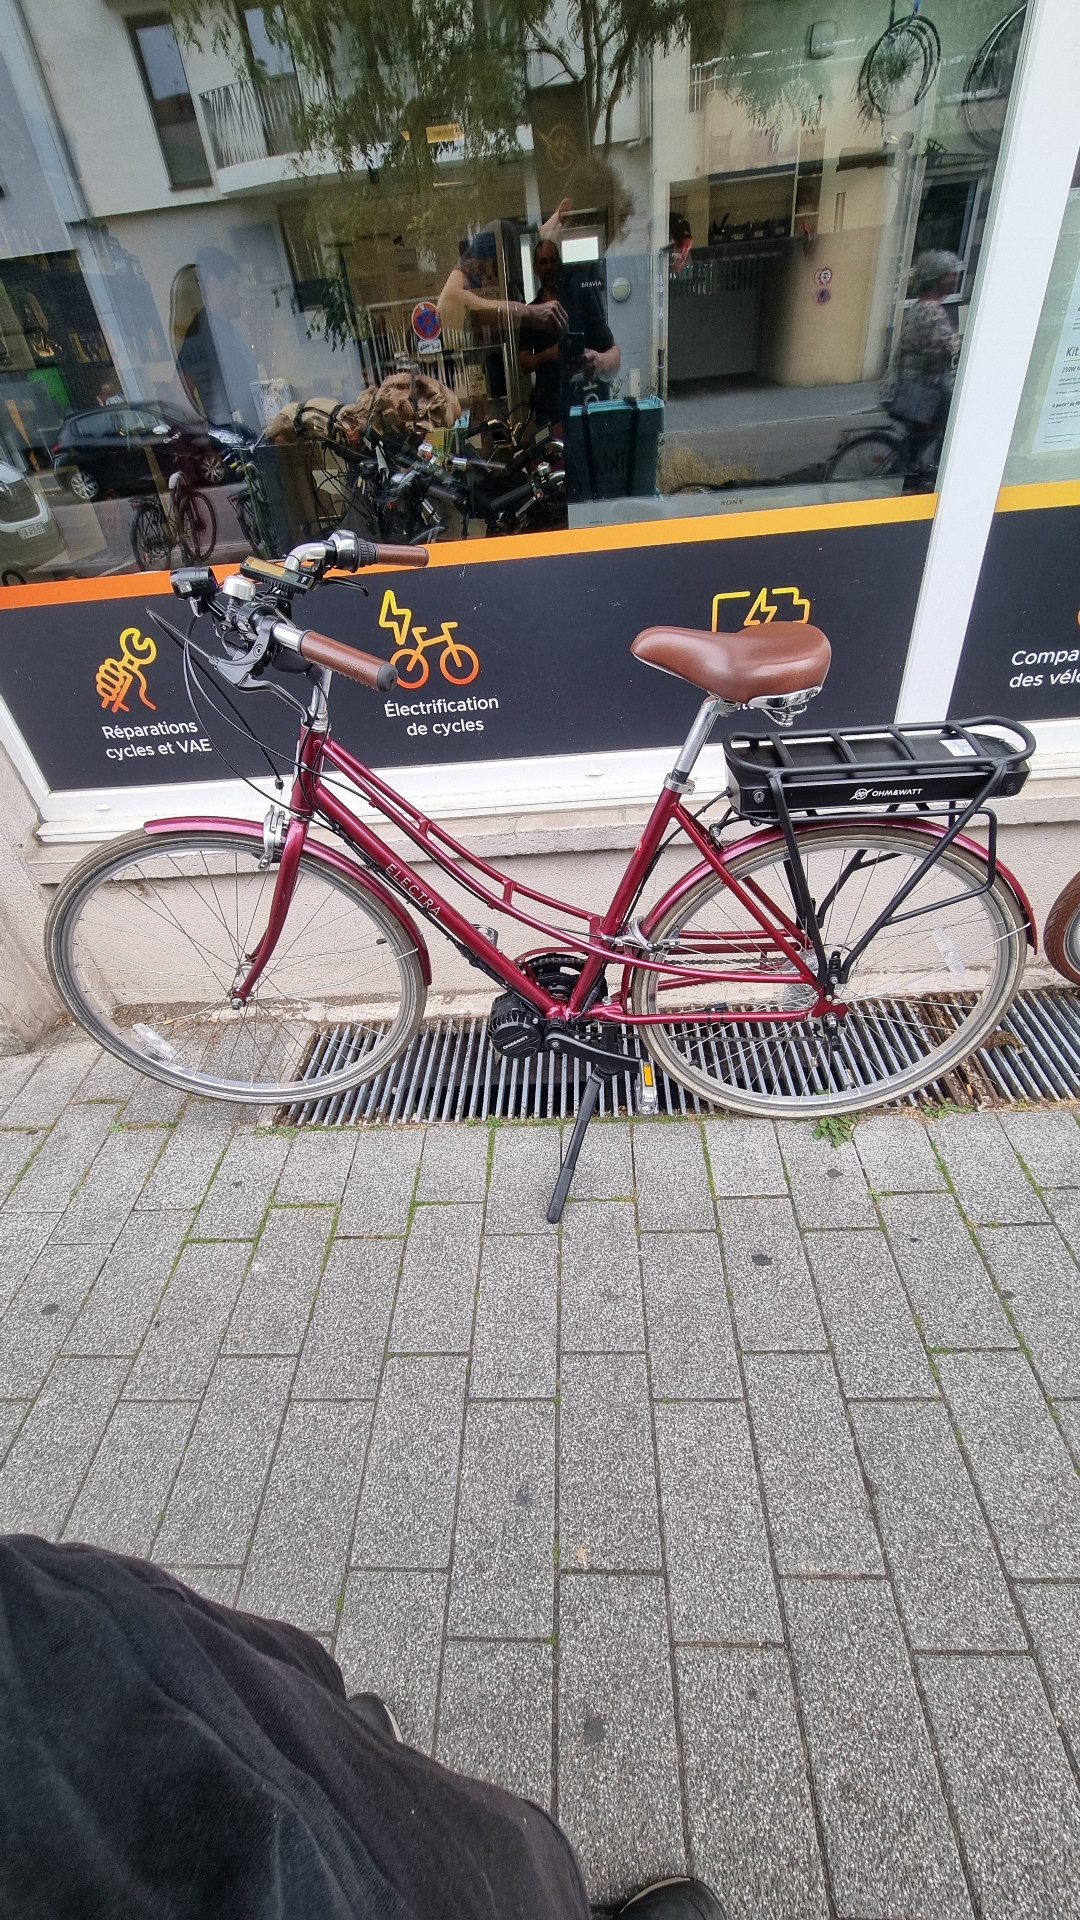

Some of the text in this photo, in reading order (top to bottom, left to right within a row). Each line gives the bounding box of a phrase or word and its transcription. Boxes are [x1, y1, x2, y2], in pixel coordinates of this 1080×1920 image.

[581, 280, 602, 288] BRAVIA
[1065, 346, 1079, 357] Kit
[1011, 649, 1080, 666] Compa
[1009, 672, 1044, 688] des
[384, 696, 499, 718] Électrification
[101, 720, 198, 740] Réparations
[406, 719, 485, 737] de cycles
[106, 738, 213, 761] cycles et VAE
[872, 788, 924, 797] OHM&WATT
[385, 863, 441, 916] ELECTRA
